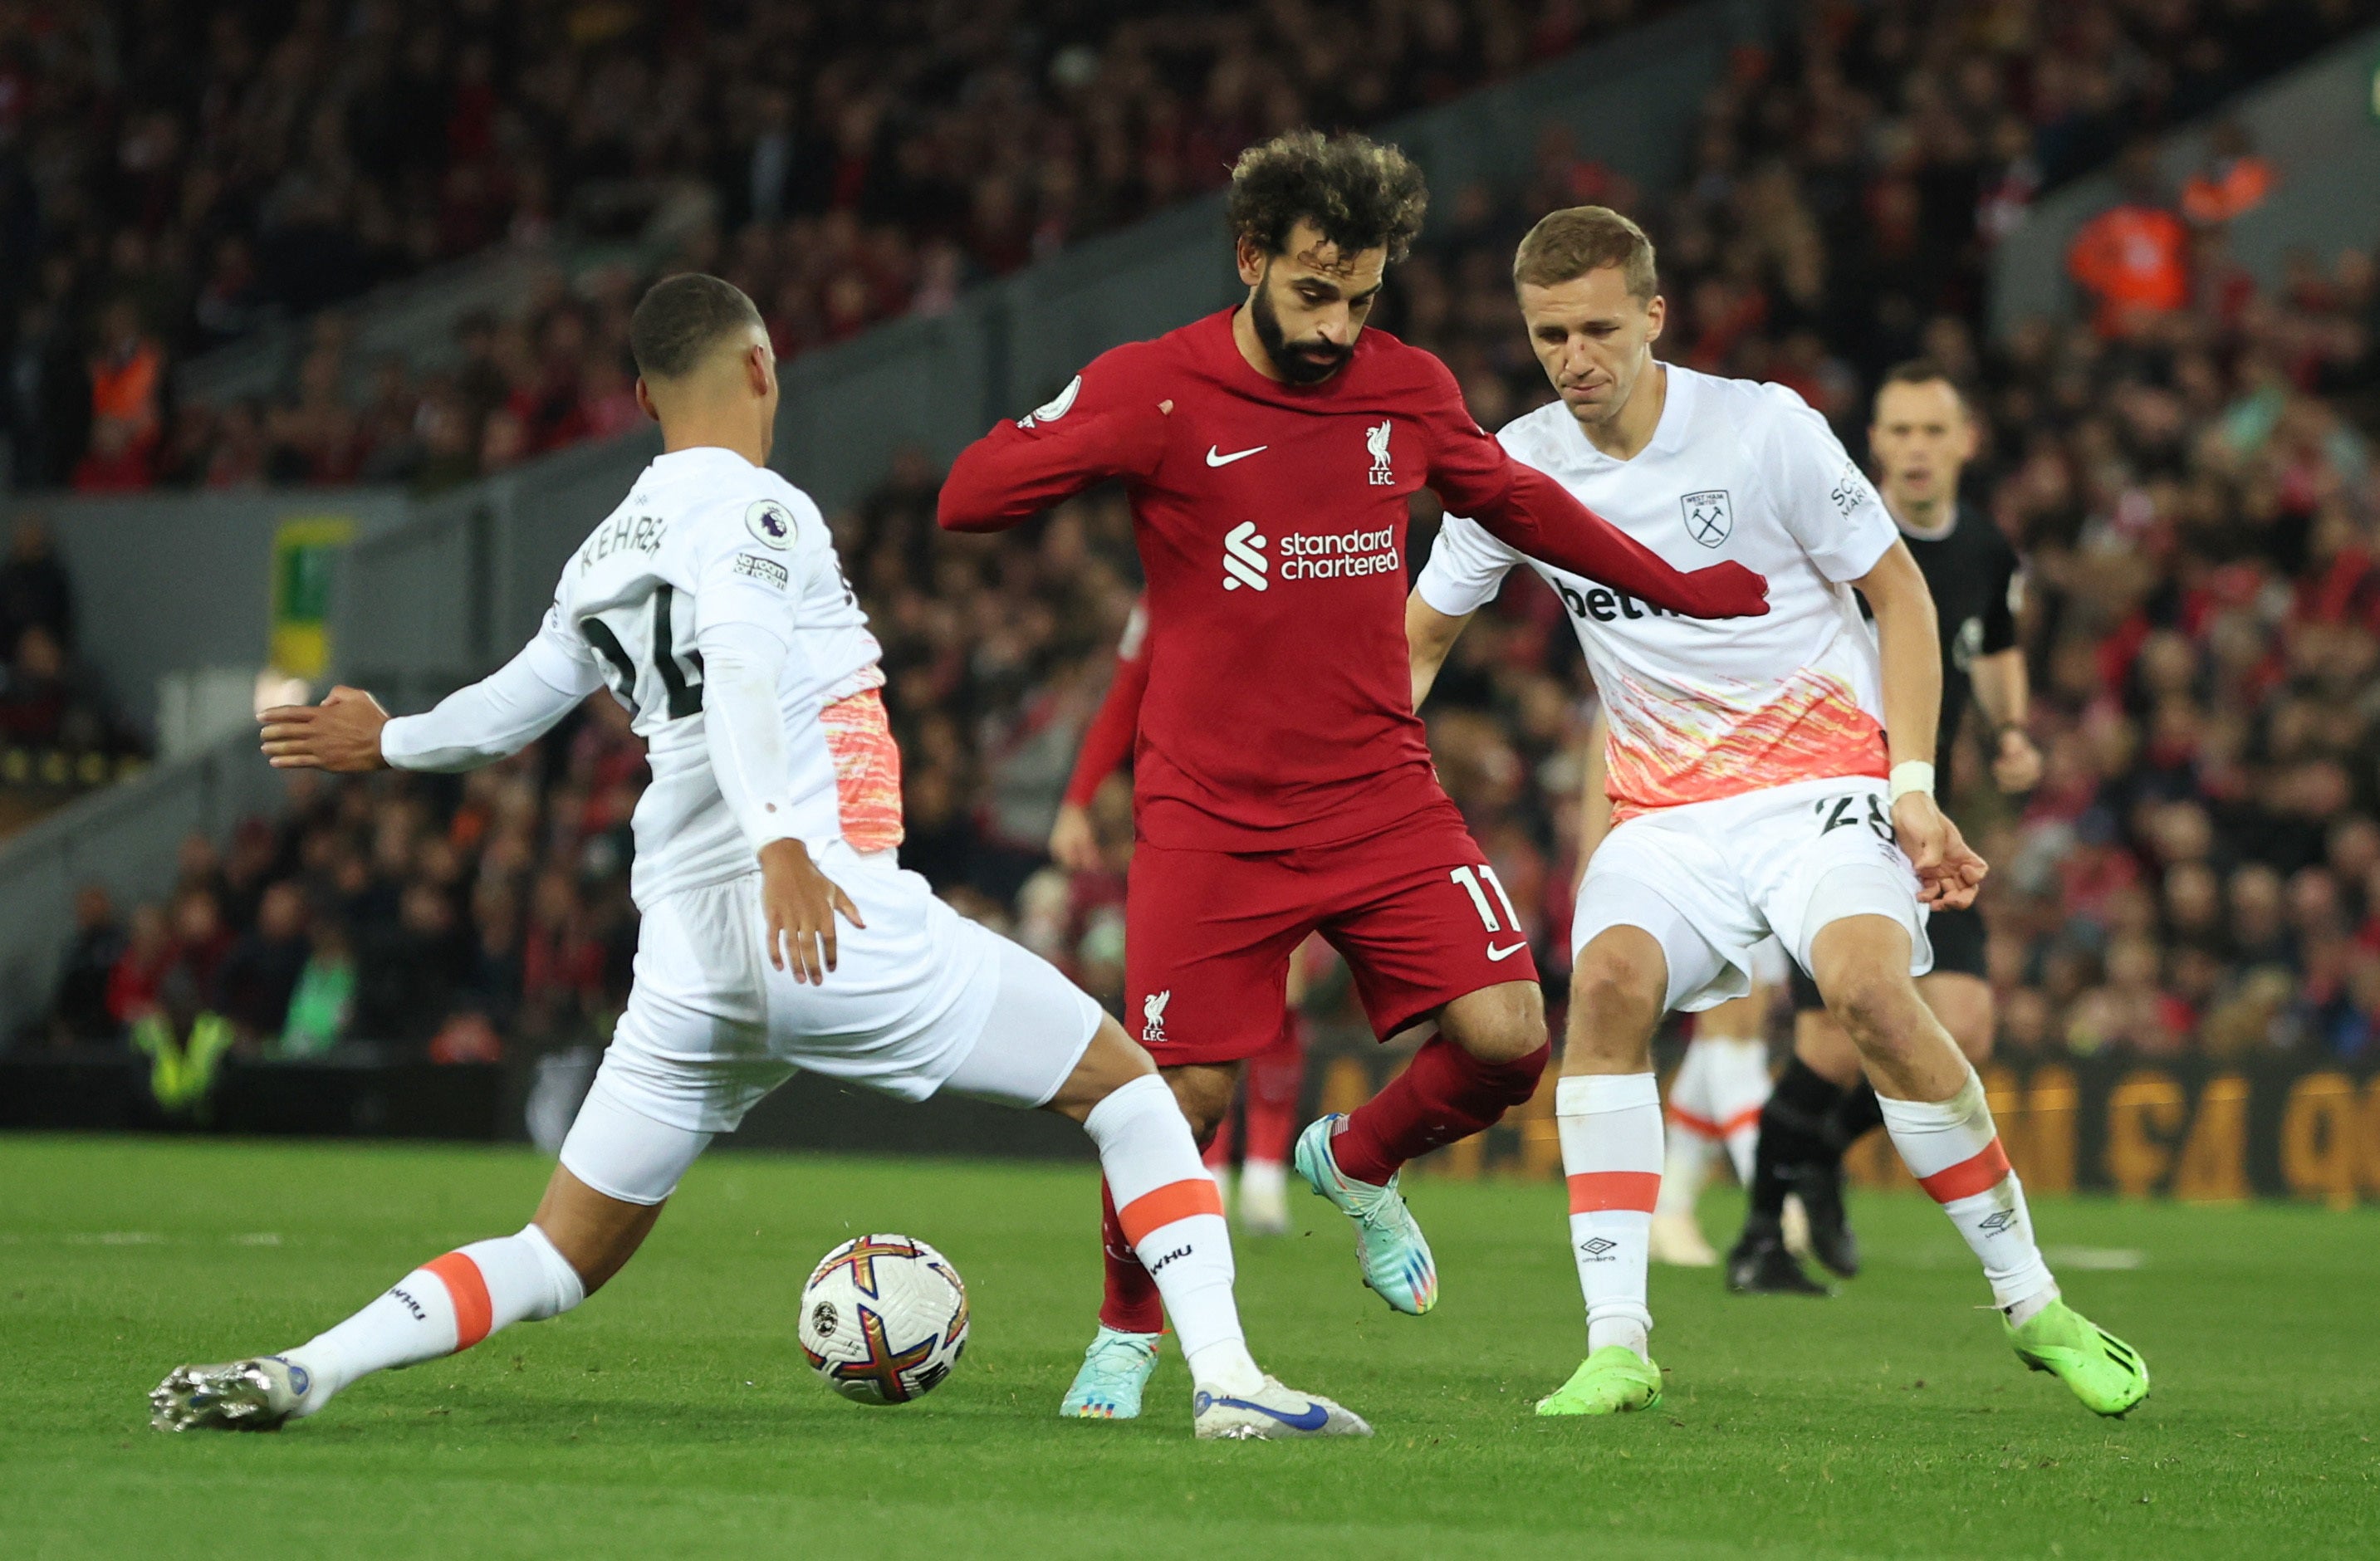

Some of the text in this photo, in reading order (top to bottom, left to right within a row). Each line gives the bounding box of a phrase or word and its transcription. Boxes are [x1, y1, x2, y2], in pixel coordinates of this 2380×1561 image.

[1280, 524, 1393, 556] standard
[736, 553, 786, 582] No room
[1281, 546, 1399, 580] chartered
[1449, 864, 1522, 932] 11
[1149, 1244, 1193, 1276] WHU
[1581, 1255, 1617, 1263] umbro
[388, 1288, 427, 1322] WHU
